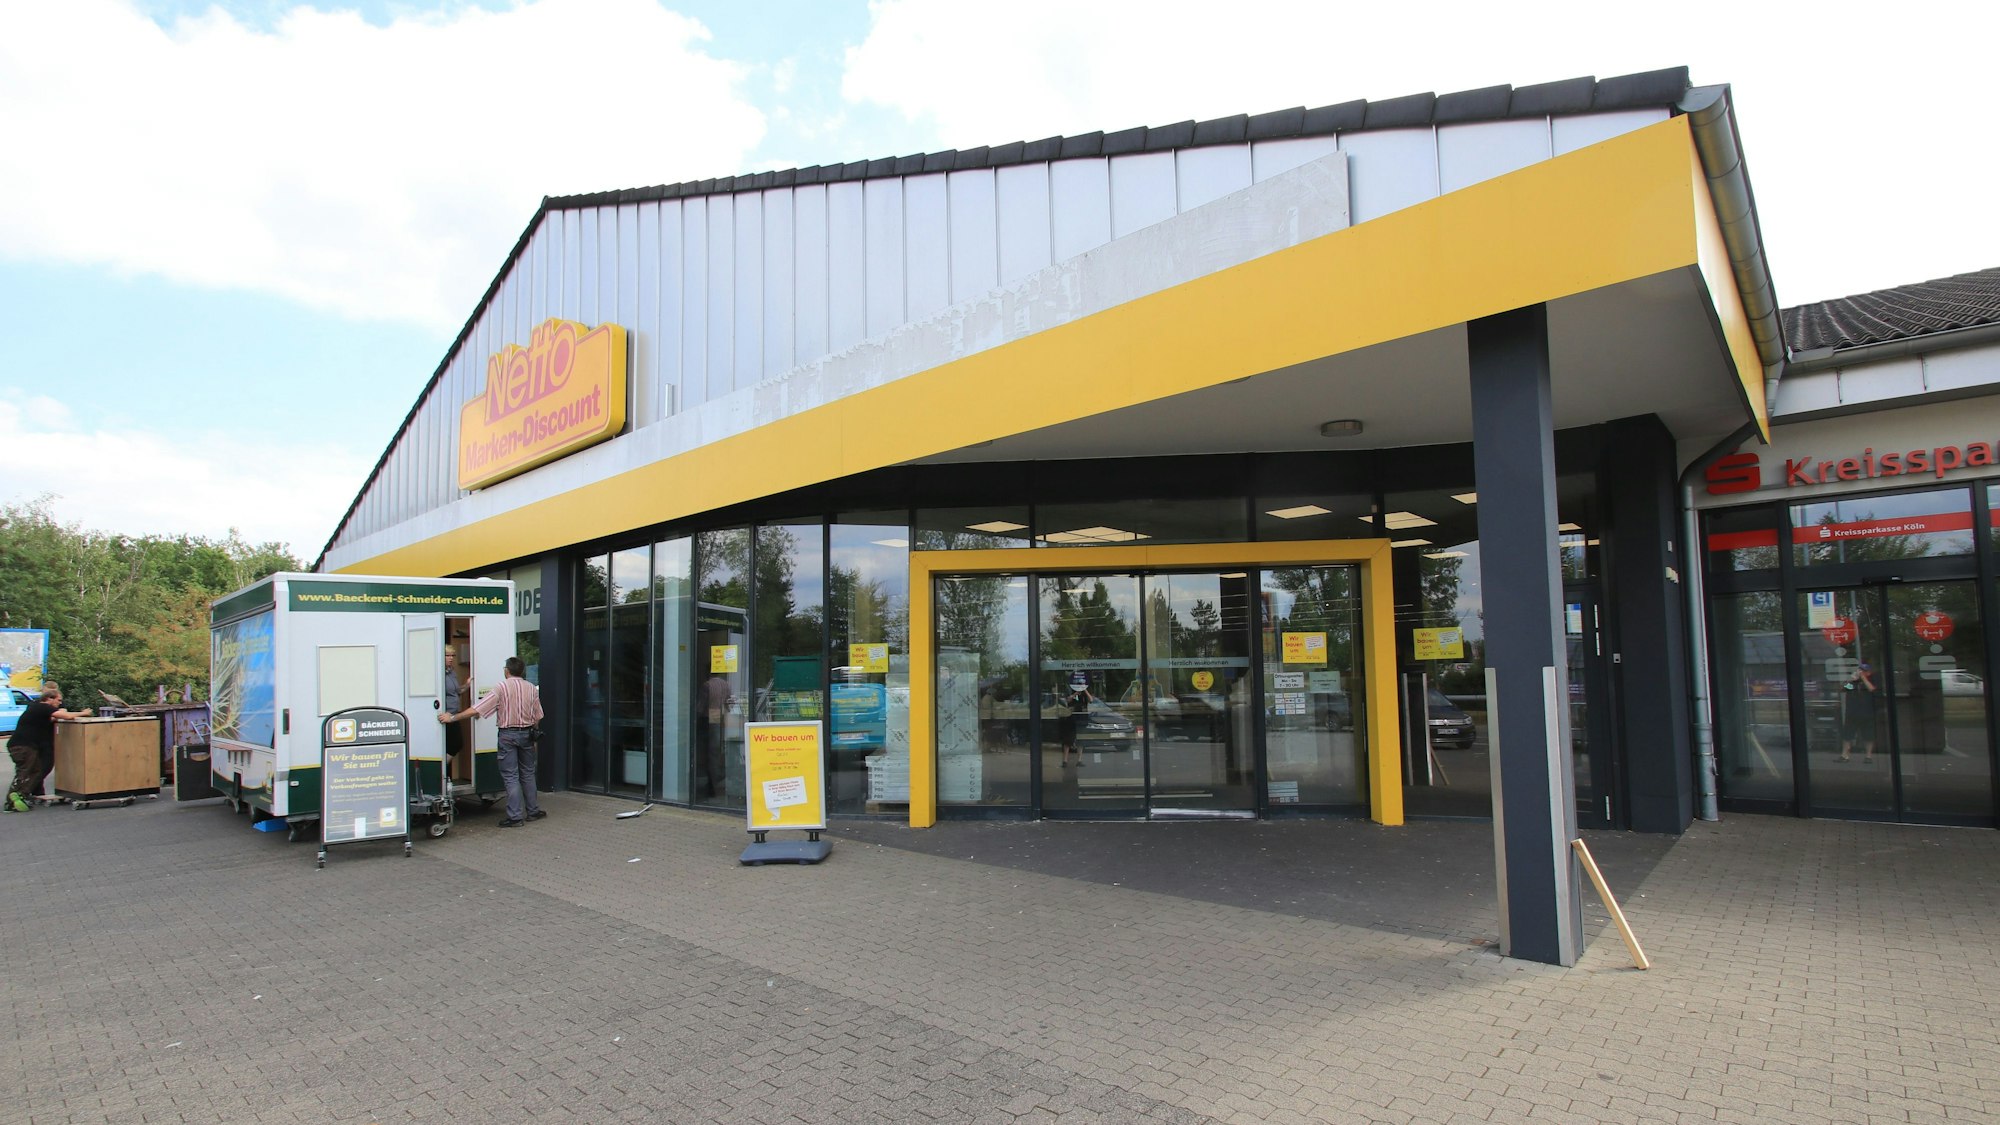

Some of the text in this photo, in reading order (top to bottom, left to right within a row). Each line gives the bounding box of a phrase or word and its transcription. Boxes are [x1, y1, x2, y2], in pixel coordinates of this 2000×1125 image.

[485, 321, 576, 423] Netto
[466, 384, 601, 473] Marken-Discount
[1786, 440, 2000, 487] Kreisspa
[1834, 522, 1925, 537] Kreissparkasse Köln
[298, 593, 503, 606] www.Baeckerei-Schneider-GmbH.de
[361, 721, 398, 729] BÄCKEREI
[358, 729, 401, 738] SCHNEIDER
[753, 734, 768, 742] Wir
[771, 734, 798, 742] bauen
[331, 751, 399, 762] Wir bauen für
[359, 760, 380, 769] um!
